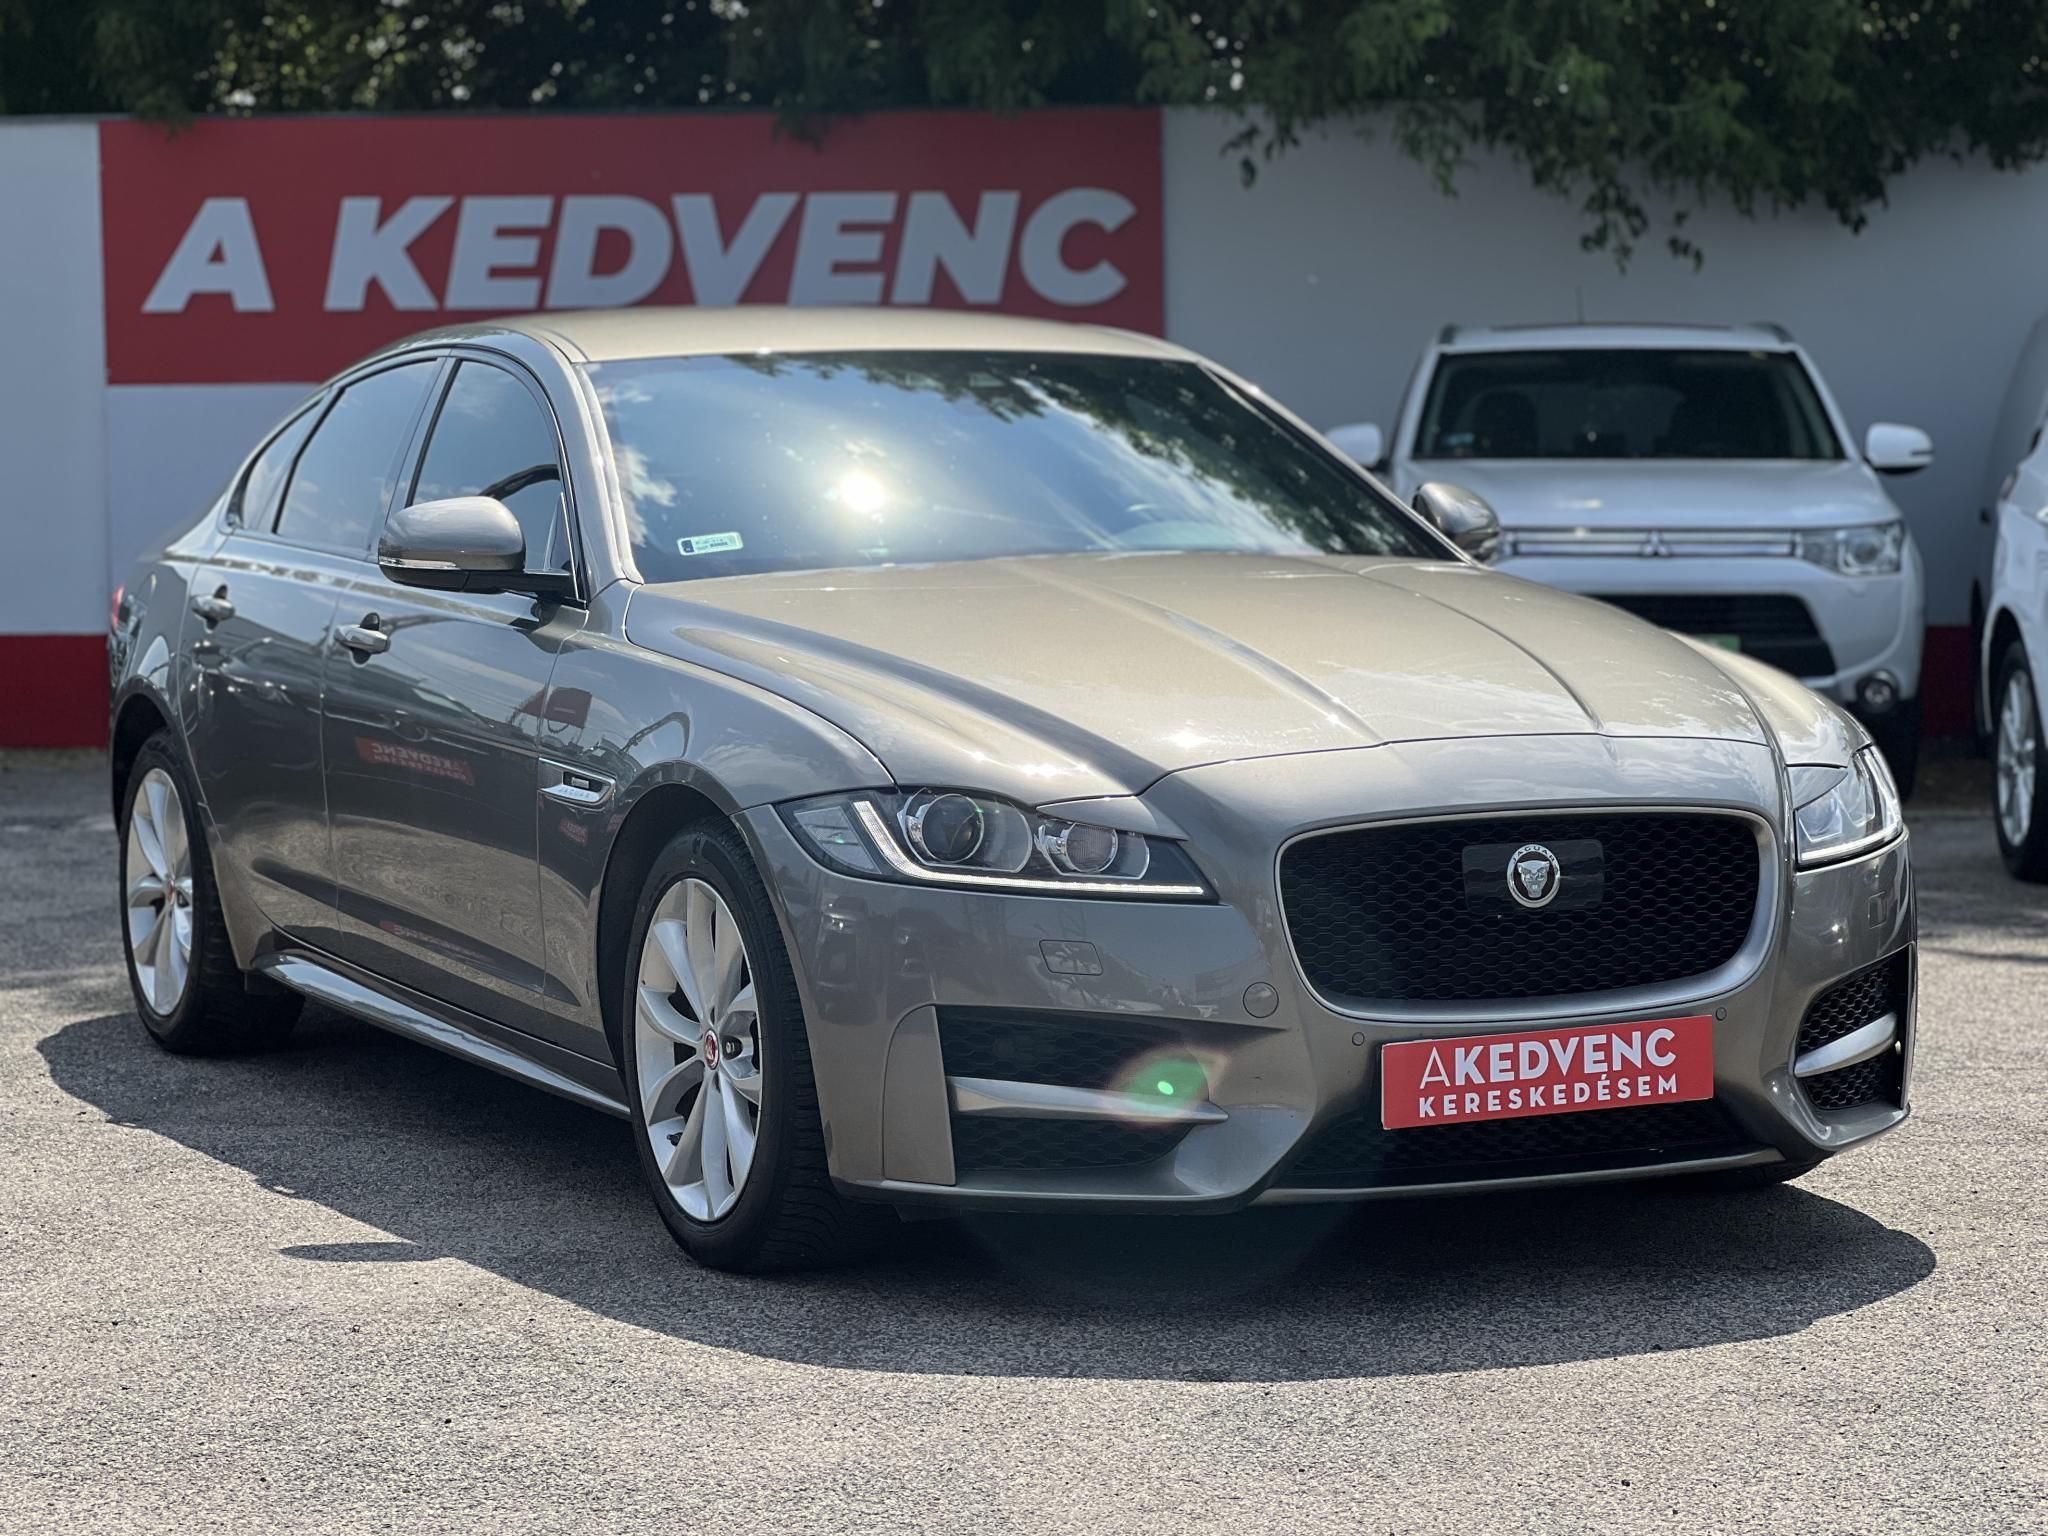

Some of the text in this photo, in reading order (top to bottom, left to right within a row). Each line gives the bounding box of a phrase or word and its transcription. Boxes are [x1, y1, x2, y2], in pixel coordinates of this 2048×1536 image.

[141, 187, 1138, 312] A KEDVENC
[1512, 845, 1556, 864] JAGUAR
[1419, 1073, 1678, 1118] KERESKEDÉSEM
